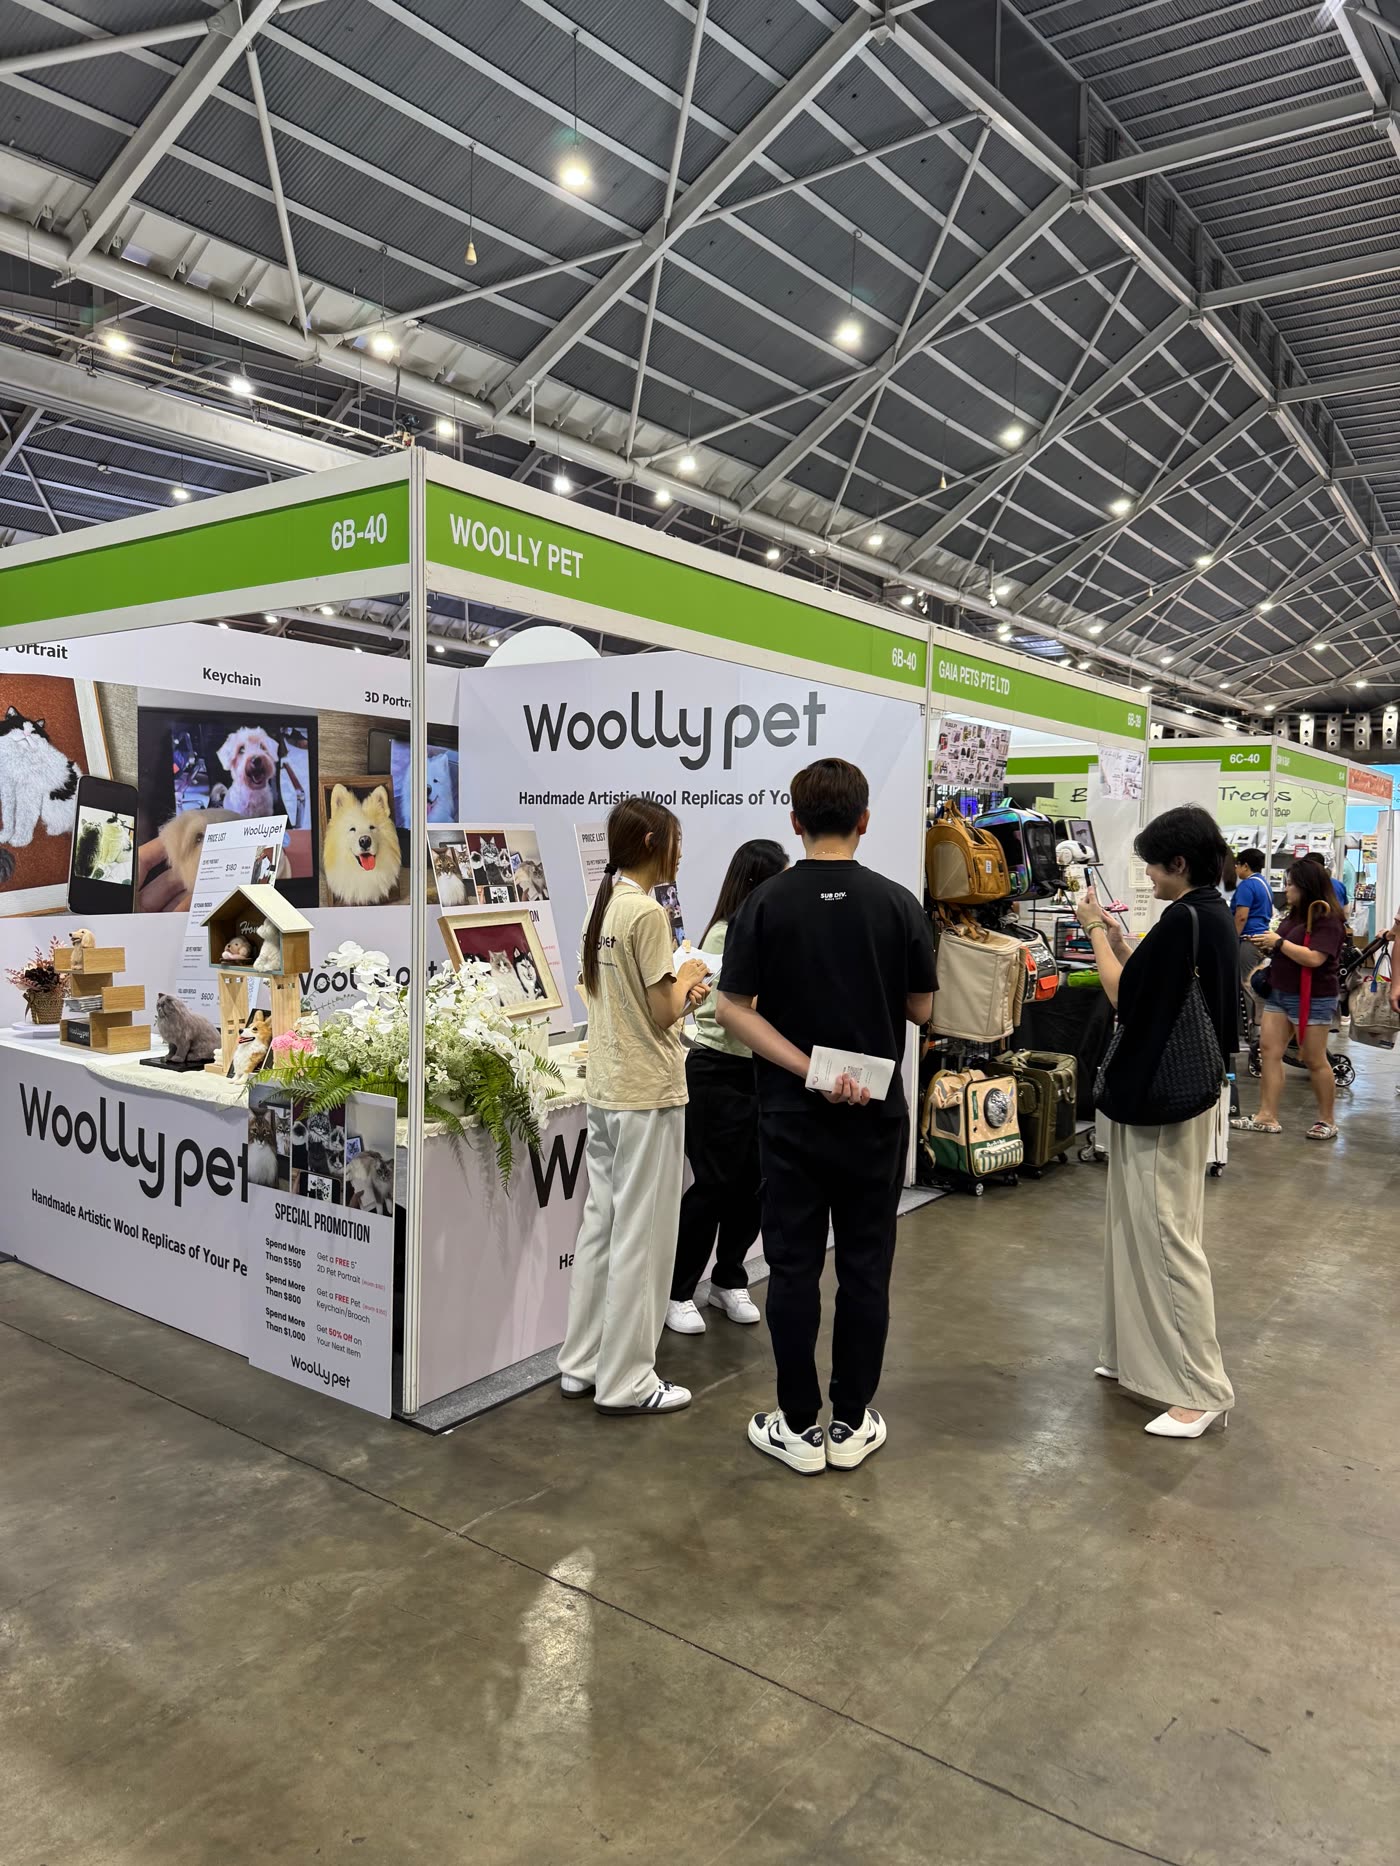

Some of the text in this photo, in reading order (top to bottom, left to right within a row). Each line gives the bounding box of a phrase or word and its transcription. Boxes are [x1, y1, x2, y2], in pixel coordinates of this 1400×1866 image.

[331, 513, 387, 551] 6B-40
[450, 513, 583, 579] WOOLLY PET
[5, 643, 68, 660] ortrait
[892, 647, 916, 671] 6B-40
[202, 667, 261, 687] Keychain
[938, 660, 1010, 696] GAIA PETS PTE LTD
[364, 691, 379, 704] 3D
[1229, 753, 1260, 764] 6C-40
[519, 791, 585, 805] Handmade
[641, 790, 677, 805] Wool
[681, 790, 744, 808] Replicas
[748, 790, 766, 805] of
[769, 790, 791, 805] Yo
[581, 832, 606, 843] PRICE LIST
[31, 1188, 248, 1276] Handmade Artistic Wool Replicas of Your Pe
[274, 1202, 370, 1243] SPECIAL PROMOTION
[266, 1238, 306, 1256] Spend More
[266, 1251, 302, 1269] Than $550
[316, 1252, 328, 1262] Get
[335, 1257, 350, 1268] FREE
[266, 1272, 306, 1292] Spend More
[316, 1264, 326, 1273] 2D
[326, 1267, 336, 1277] Pet
[338, 1270, 360, 1284] Portrait
[266, 1286, 302, 1304] Than $800
[316, 1288, 328, 1298] Get
[334, 1293, 350, 1304] FREE
[350, 1298, 360, 1308] Pet
[266, 1307, 306, 1327] Spend More
[316, 1300, 370, 1324] Keychain/Brooch
[266, 1320, 306, 1342] Than $1,000
[316, 1324, 362, 1346] Get 50% Off on
[316, 1337, 361, 1358] Your Next Item
